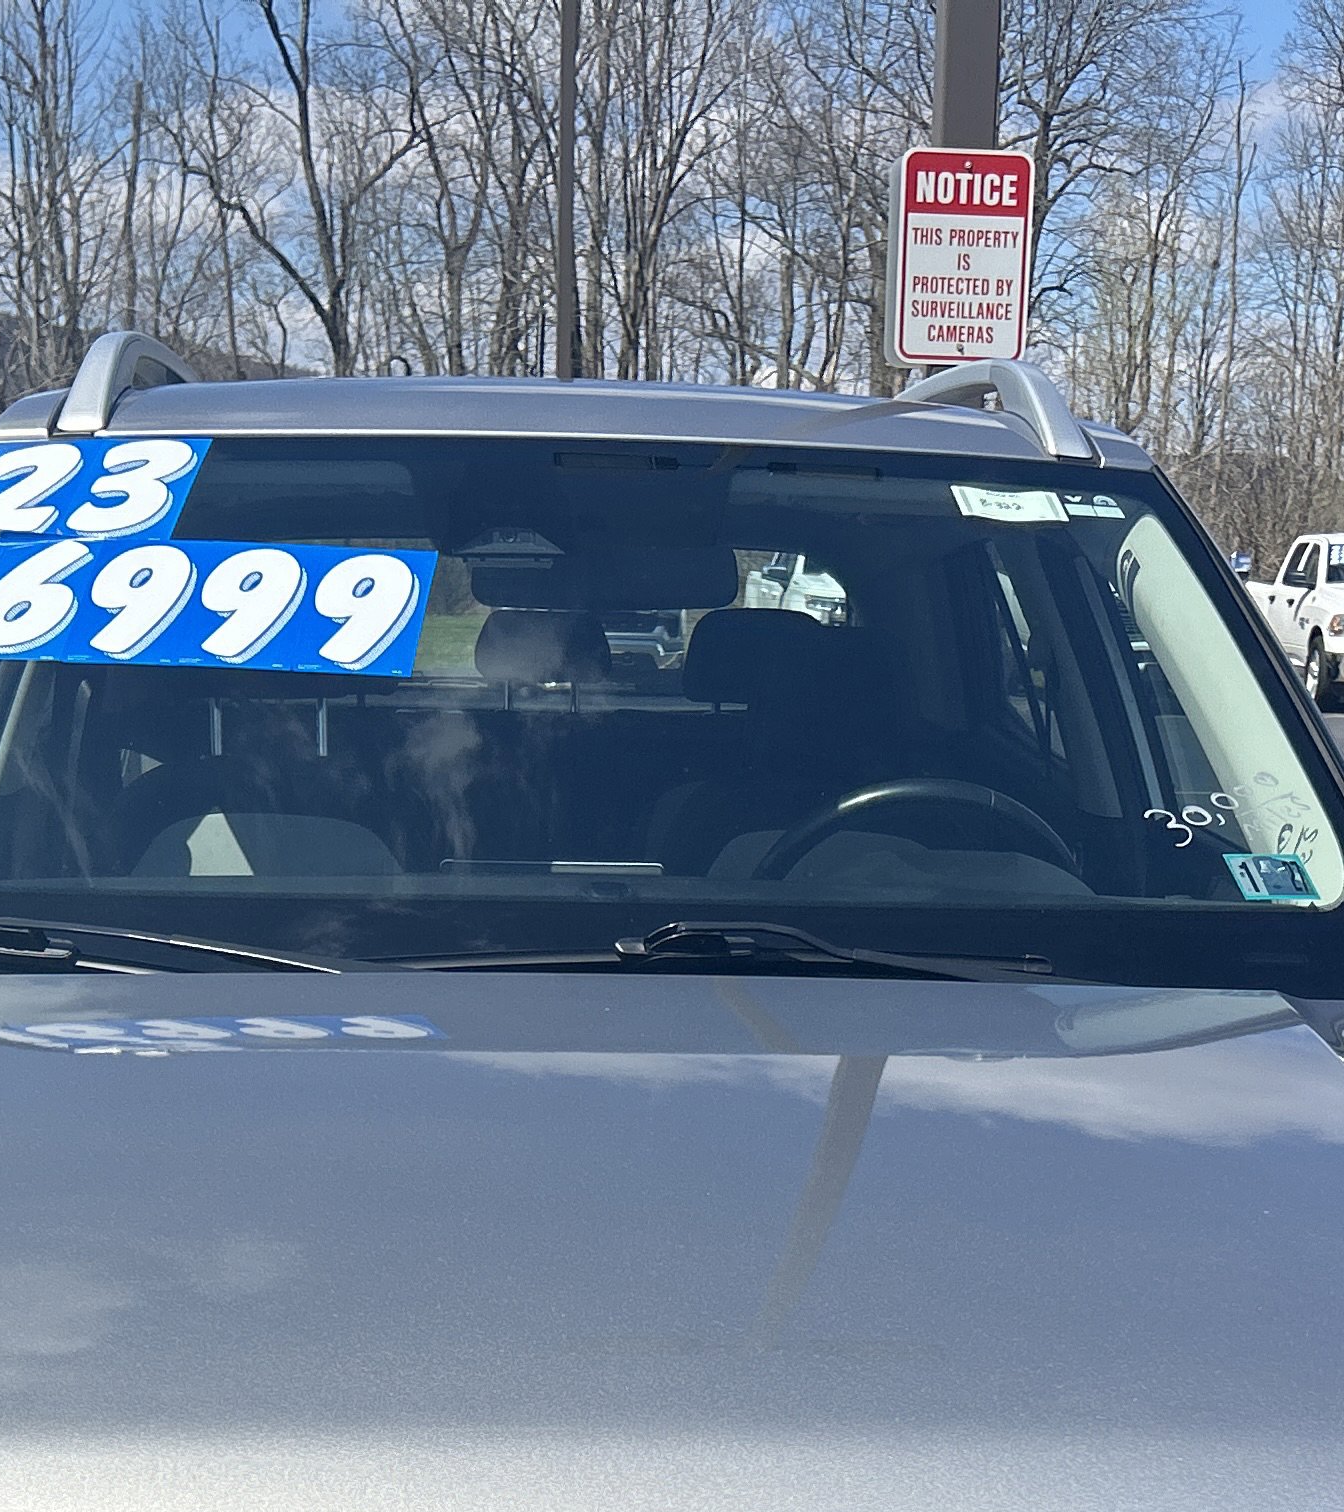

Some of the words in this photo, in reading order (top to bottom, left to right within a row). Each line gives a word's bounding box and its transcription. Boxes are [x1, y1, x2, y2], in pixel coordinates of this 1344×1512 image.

[916, 171, 1018, 206] NOTICE
[912, 228, 942, 245] THIS
[949, 229, 1019, 248] PROPERTY
[957, 253, 971, 270] IS
[913, 276, 989, 296] PROTECTED
[996, 279, 1013, 296] BY
[911, 300, 1013, 321] SURVEILLANCE
[927, 324, 994, 344] CAMERAS
